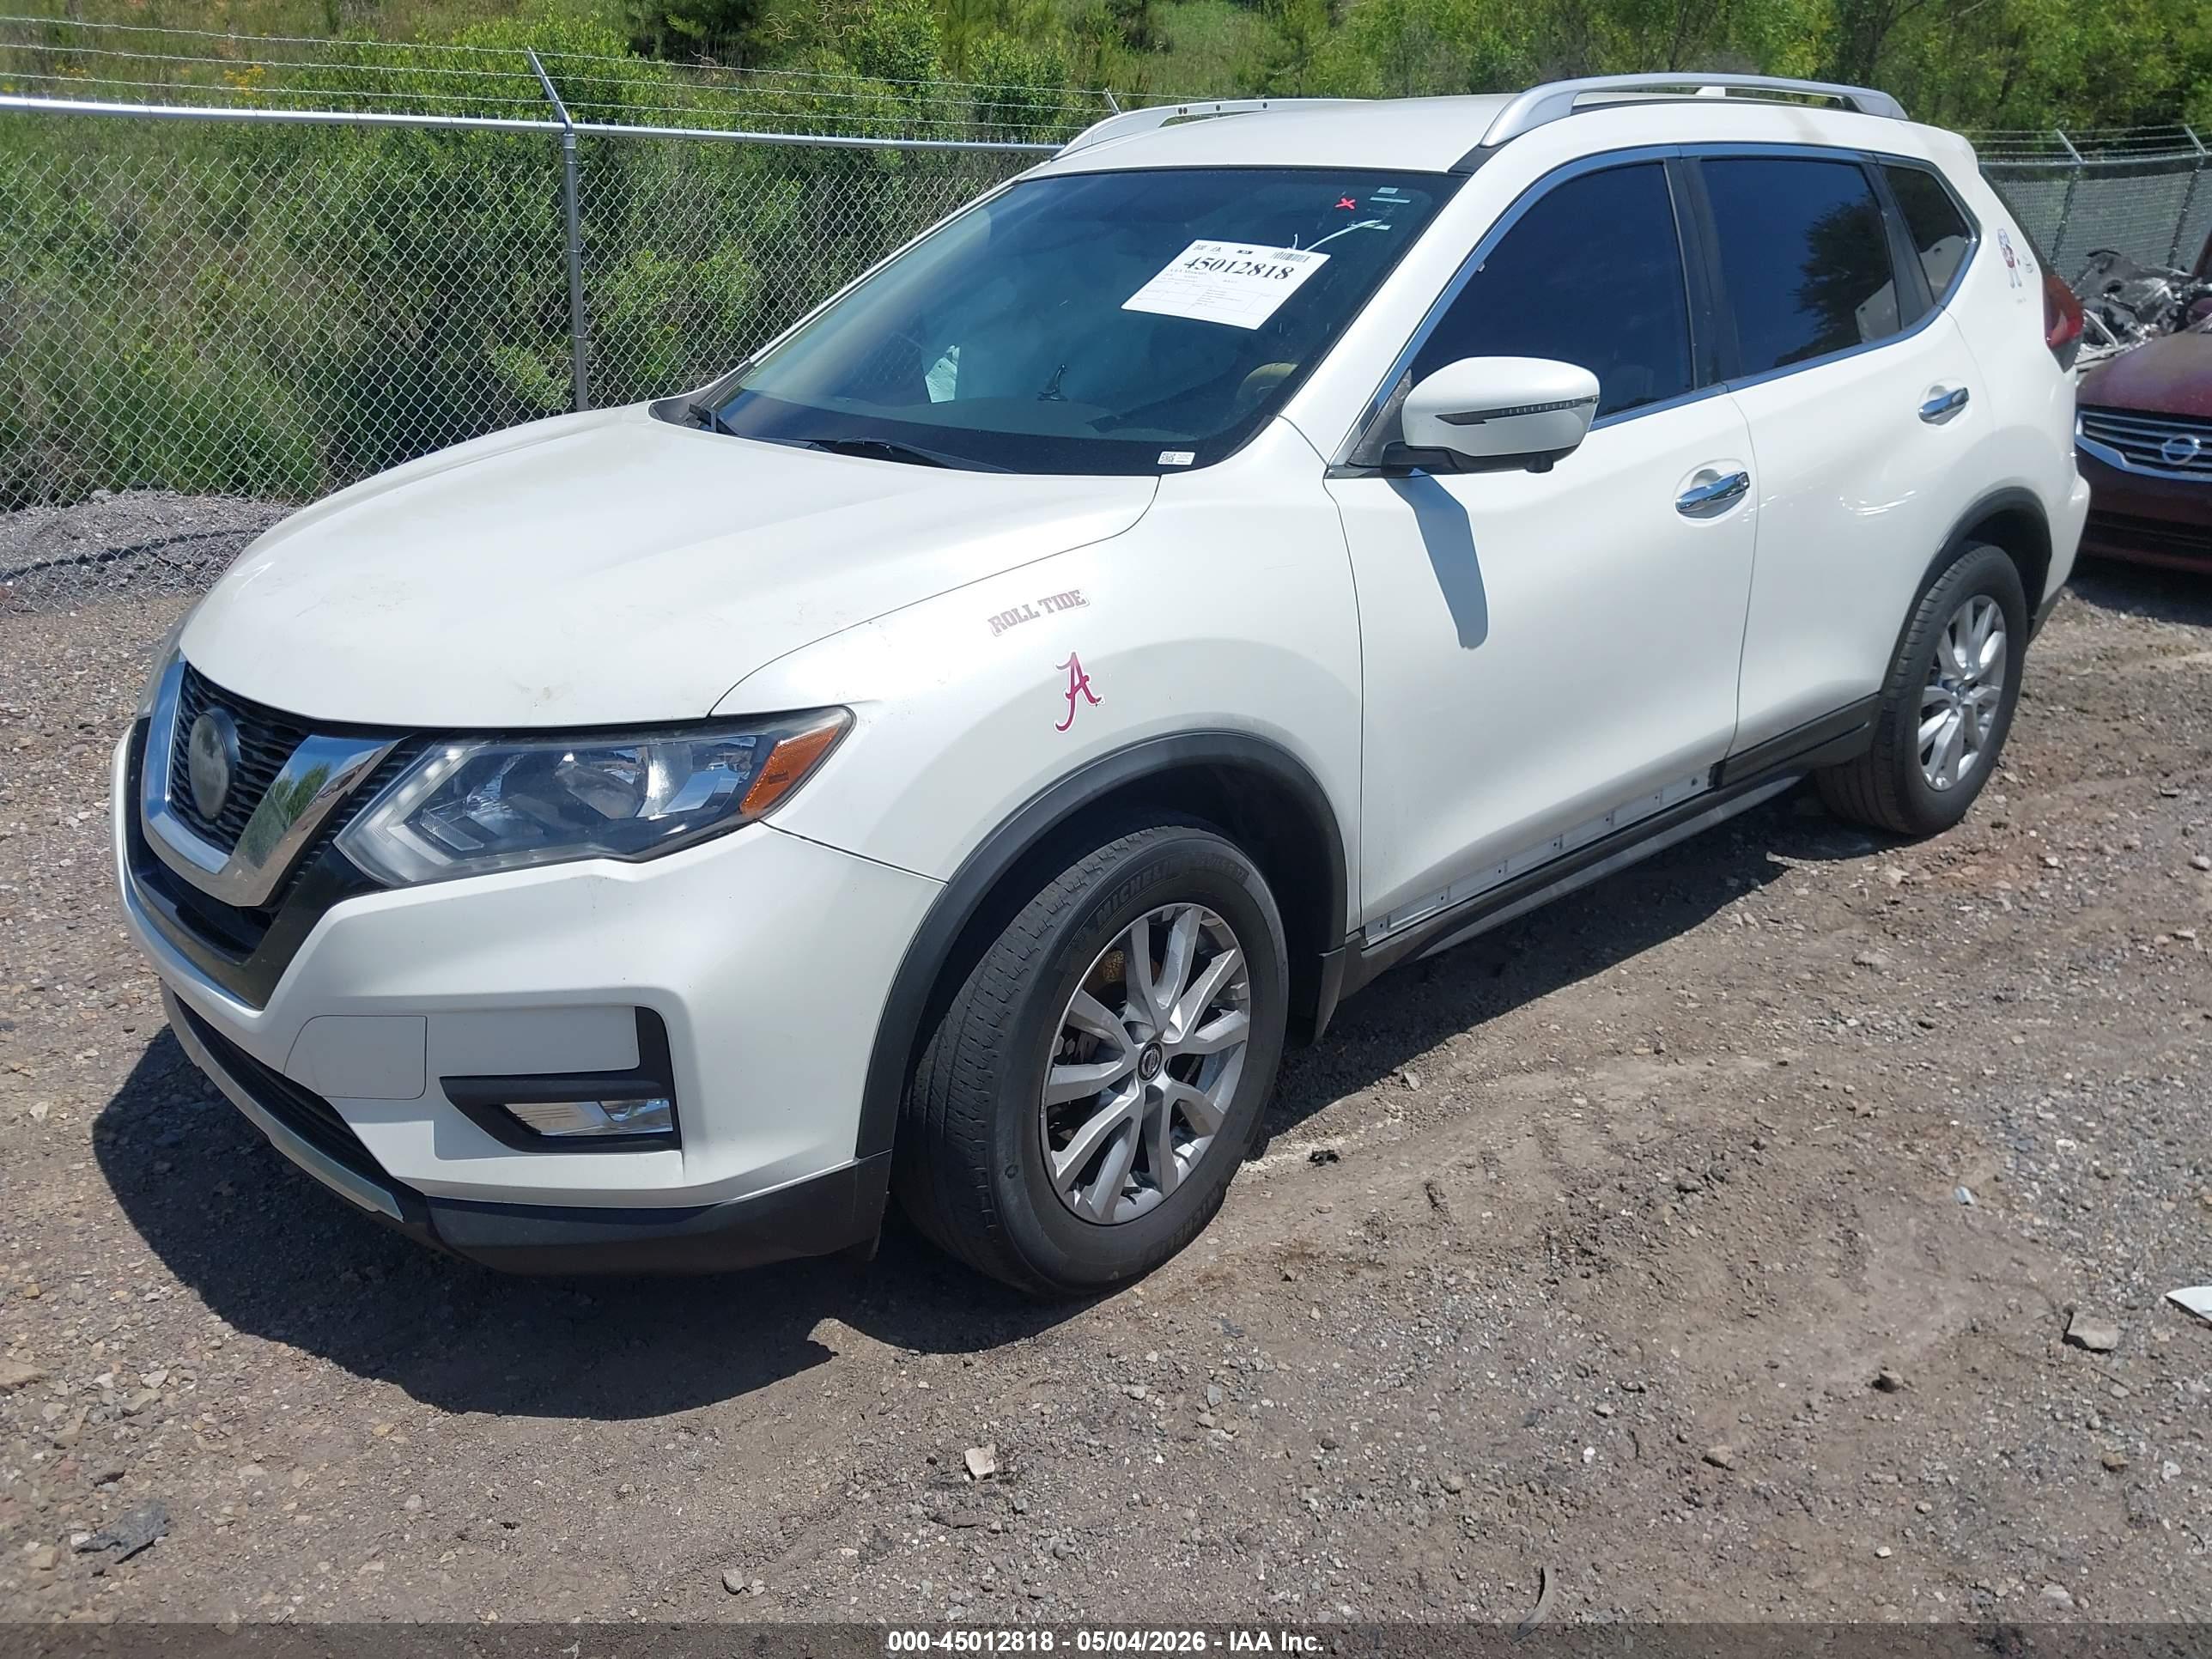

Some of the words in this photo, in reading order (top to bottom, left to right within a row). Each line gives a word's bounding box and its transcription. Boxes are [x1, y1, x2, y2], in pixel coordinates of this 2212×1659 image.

[1184, 256, 1295, 281] 45012818
[988, 604, 1041, 635] ROLL
[1037, 589, 1087, 614] TIDE
